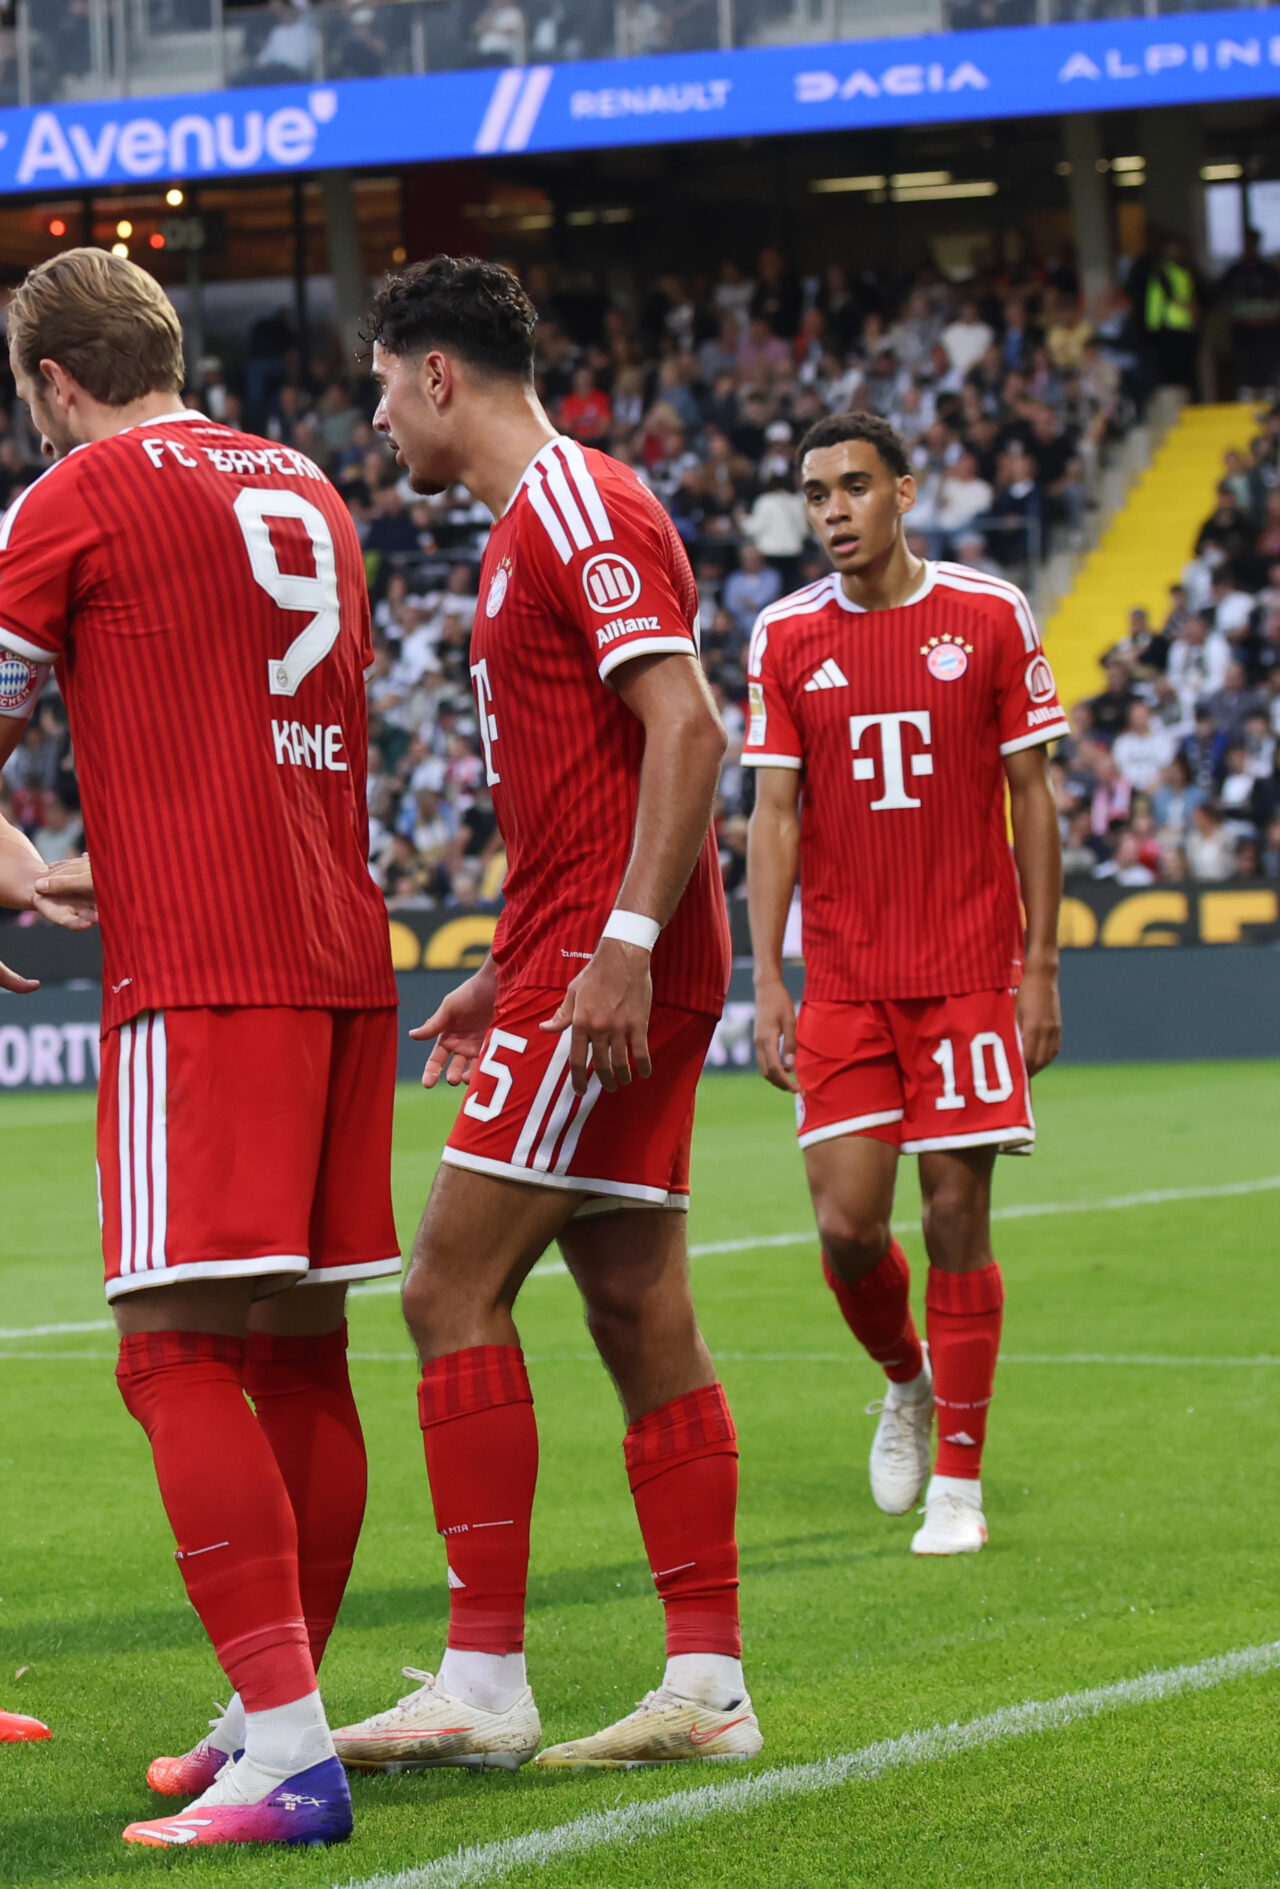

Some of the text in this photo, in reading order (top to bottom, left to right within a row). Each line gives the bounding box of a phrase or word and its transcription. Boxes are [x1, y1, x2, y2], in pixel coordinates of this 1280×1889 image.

[571, 79, 732, 120] RENAULT
[796, 63, 989, 102] DACIA
[17, 106, 317, 184] Avenue
[141, 438, 198, 469] FC
[233, 487, 341, 696] 9
[595, 615, 662, 650] Allianz
[271, 719, 348, 771] KANE
[849, 710, 934, 811] T
[463, 1027, 529, 1123] 5
[932, 1032, 1014, 1111] 10
